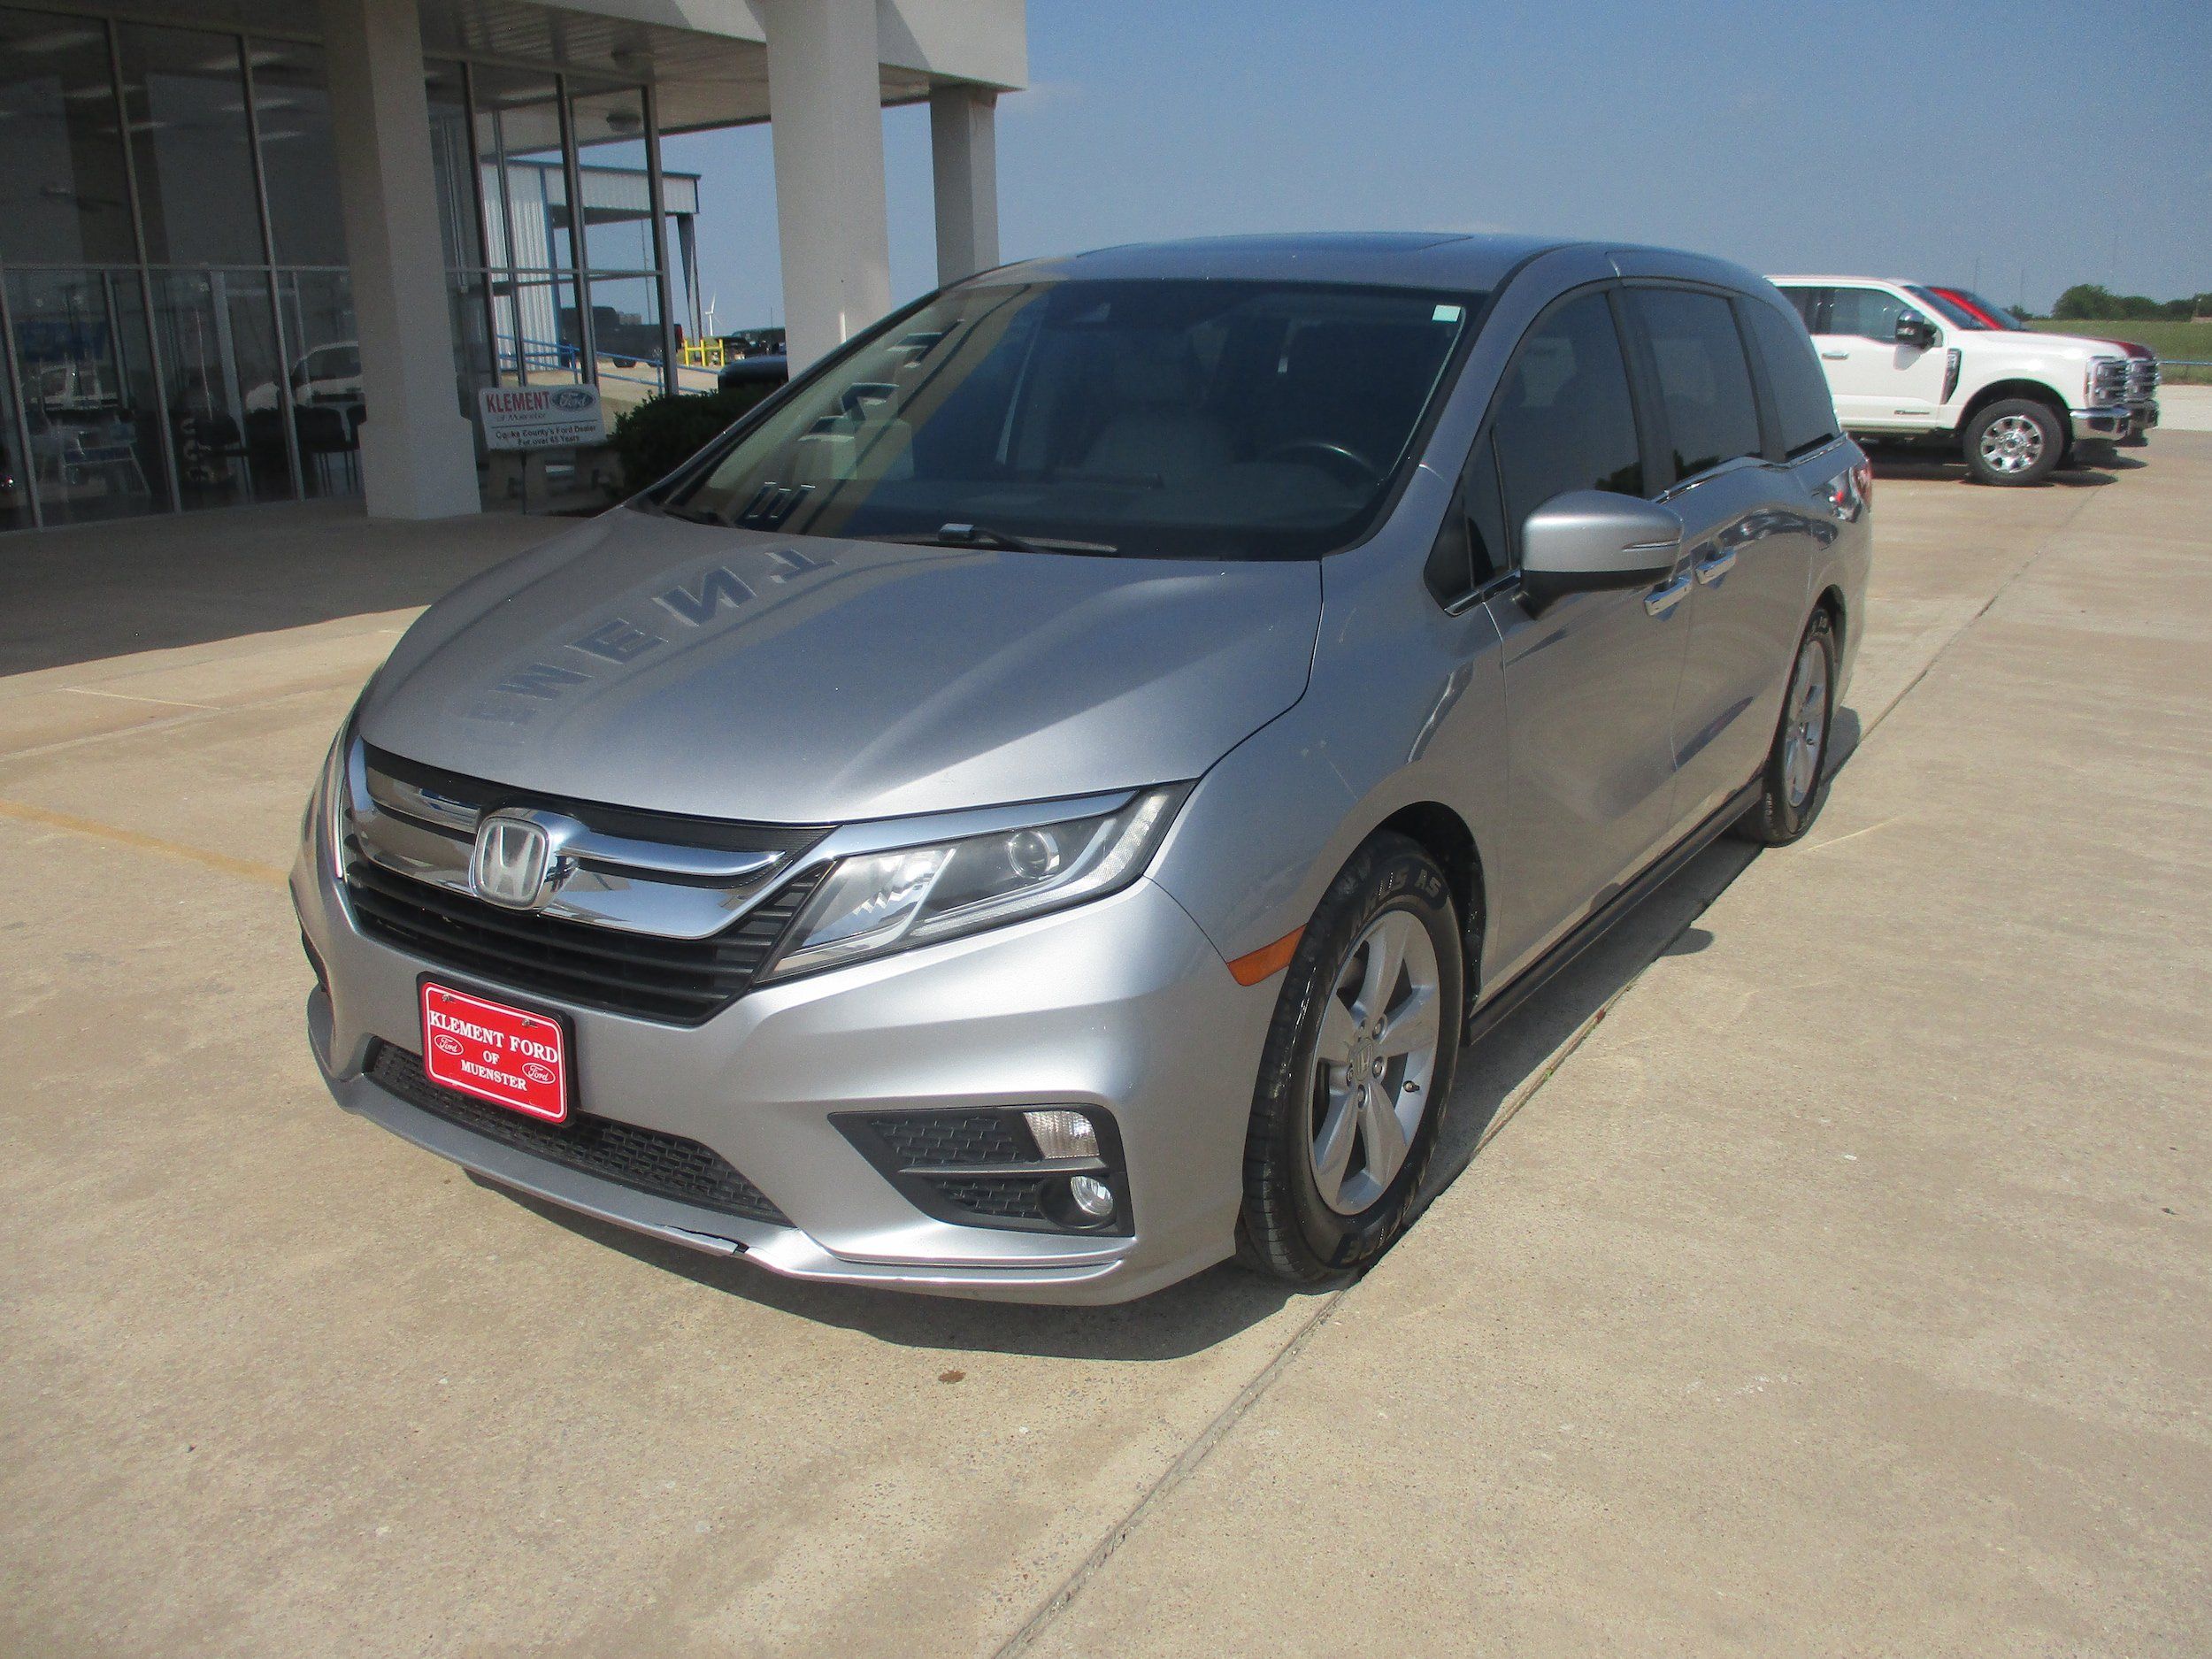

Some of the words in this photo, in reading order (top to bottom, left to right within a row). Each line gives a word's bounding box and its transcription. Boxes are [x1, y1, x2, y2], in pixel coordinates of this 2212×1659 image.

[487, 392, 550, 413] KLEMENT
[556, 425, 573, 434] Ford
[429, 1010, 504, 1048] KLEMENT
[509, 1035, 558, 1064] FORD
[438, 1036, 460, 1054] Ford
[482, 1050, 500, 1064] OF
[460, 1059, 528, 1091] MUENSTER
[526, 1064, 553, 1083] Ford
